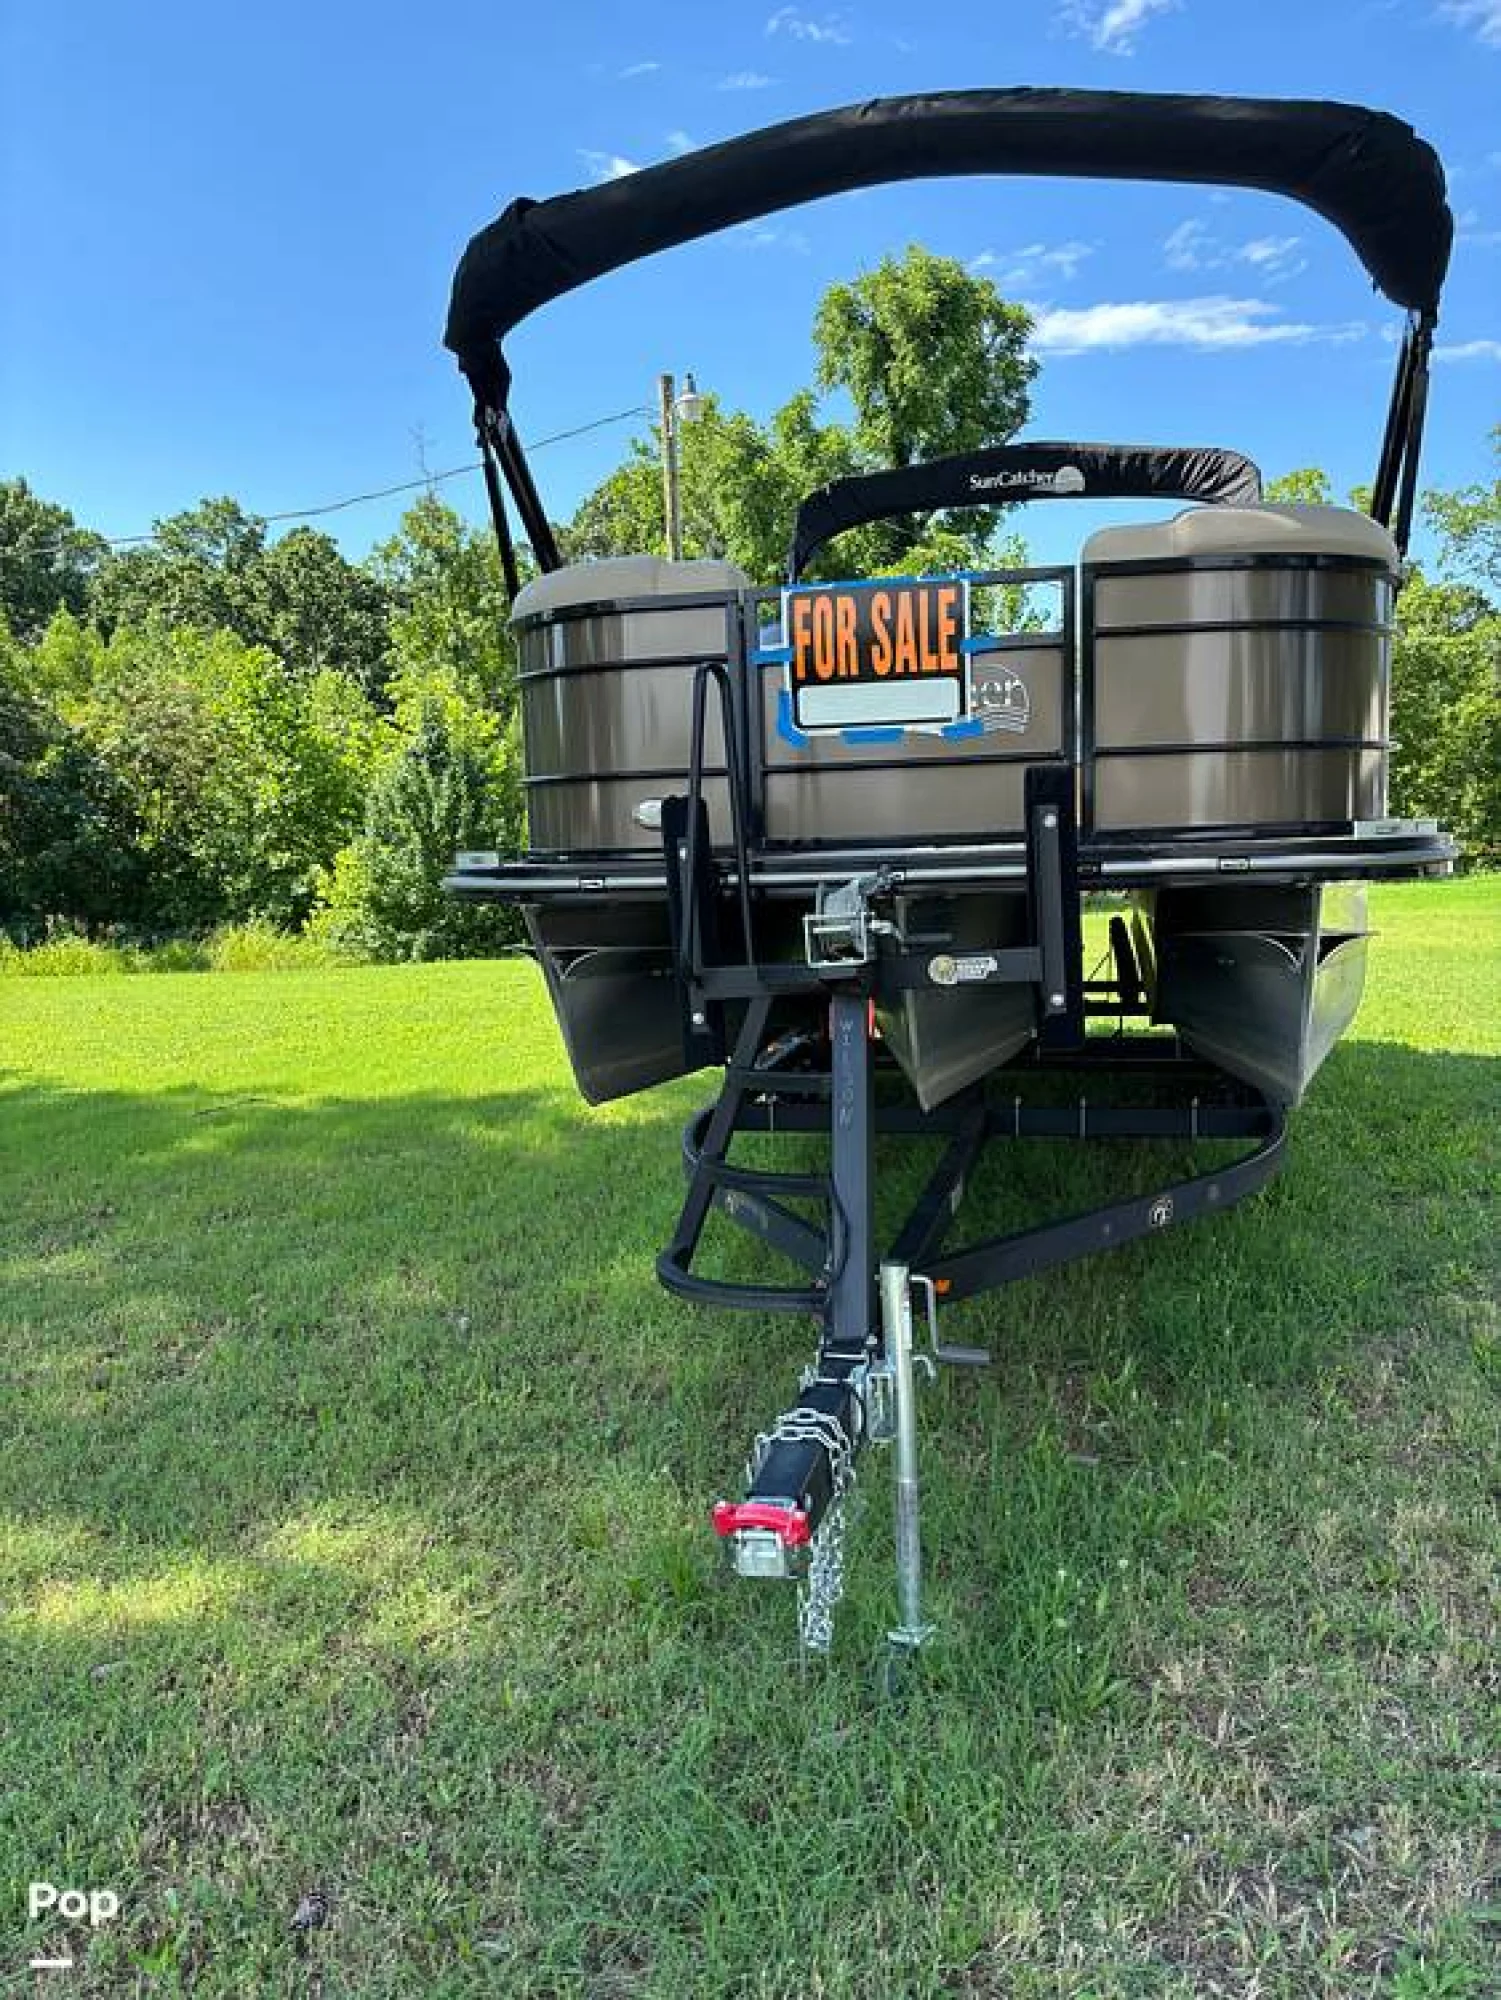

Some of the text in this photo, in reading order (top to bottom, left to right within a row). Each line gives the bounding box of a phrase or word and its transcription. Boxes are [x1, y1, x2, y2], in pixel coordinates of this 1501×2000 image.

[970, 469, 1056, 491] SunCatcher
[793, 588, 958, 680] FOR SALE
